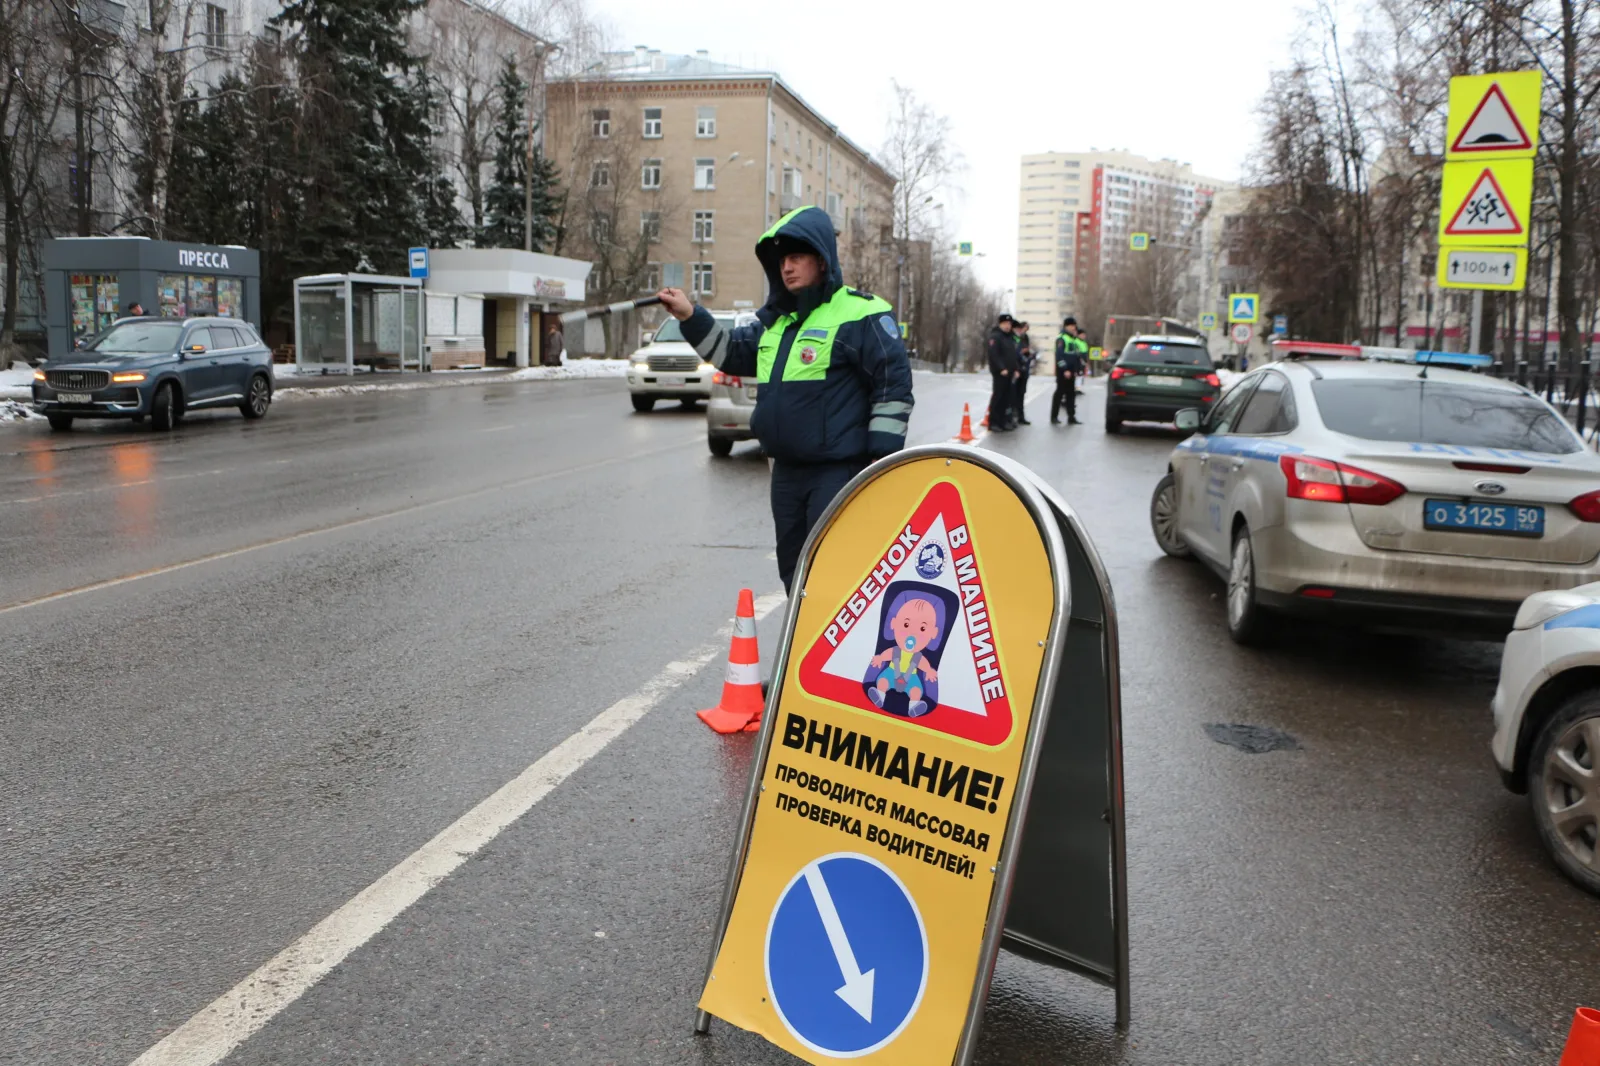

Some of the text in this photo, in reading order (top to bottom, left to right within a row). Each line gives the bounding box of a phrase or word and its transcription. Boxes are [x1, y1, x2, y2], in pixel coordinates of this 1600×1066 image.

[179, 249, 229, 269] ПРЕССА
[1463, 261, 1487, 273] 100
[1455, 505, 1506, 527] 3125
[1517, 508, 1538, 523] 50
[823, 524, 921, 648] РЕБЕНОК
[948, 524, 1004, 703] В МАШИНЕ
[782, 712, 1005, 814] ВНИМАНИЕ!
[775, 763, 990, 852] ПРОВОДИТСЯ МАССОВАЯ
[775, 792, 976, 880] ПРОВЕРКА ВОДИТЕЛЕЙ!
